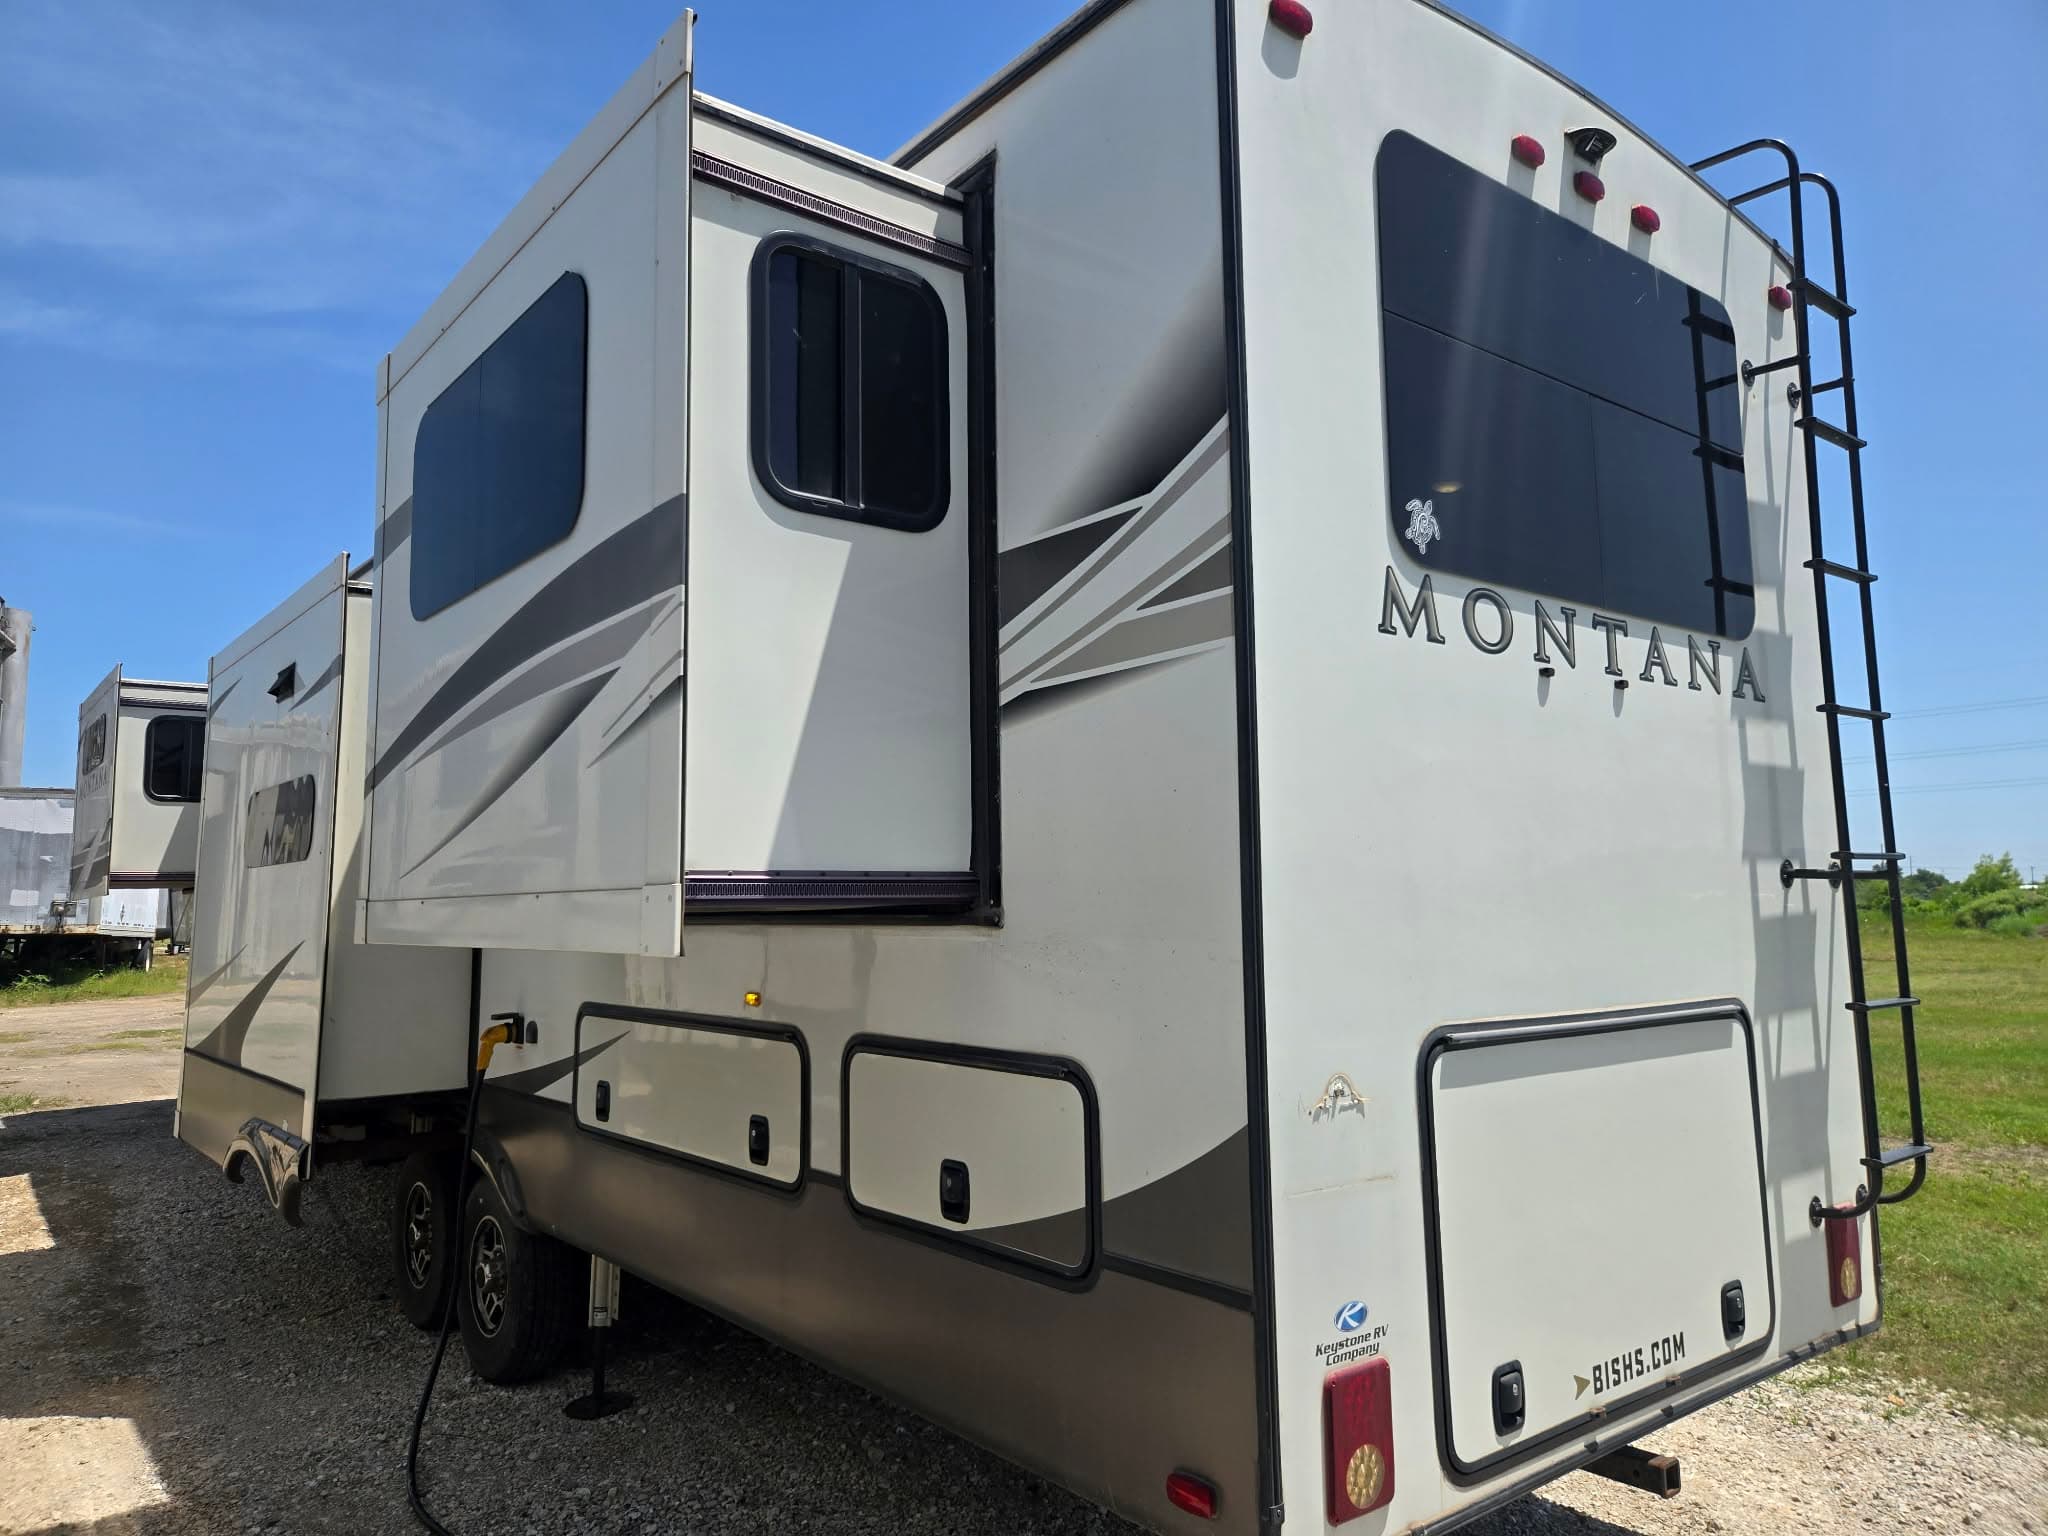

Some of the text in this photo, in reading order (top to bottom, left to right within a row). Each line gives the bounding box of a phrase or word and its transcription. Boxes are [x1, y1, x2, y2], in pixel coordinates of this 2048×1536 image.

[1377, 565, 1766, 703] MONTANA
[1337, 1302, 1364, 1329] K
[1315, 1324, 1389, 1357] Keystone RV
[1325, 1342, 1380, 1366] Company
[1592, 1331, 1686, 1395] BISHS.COM
